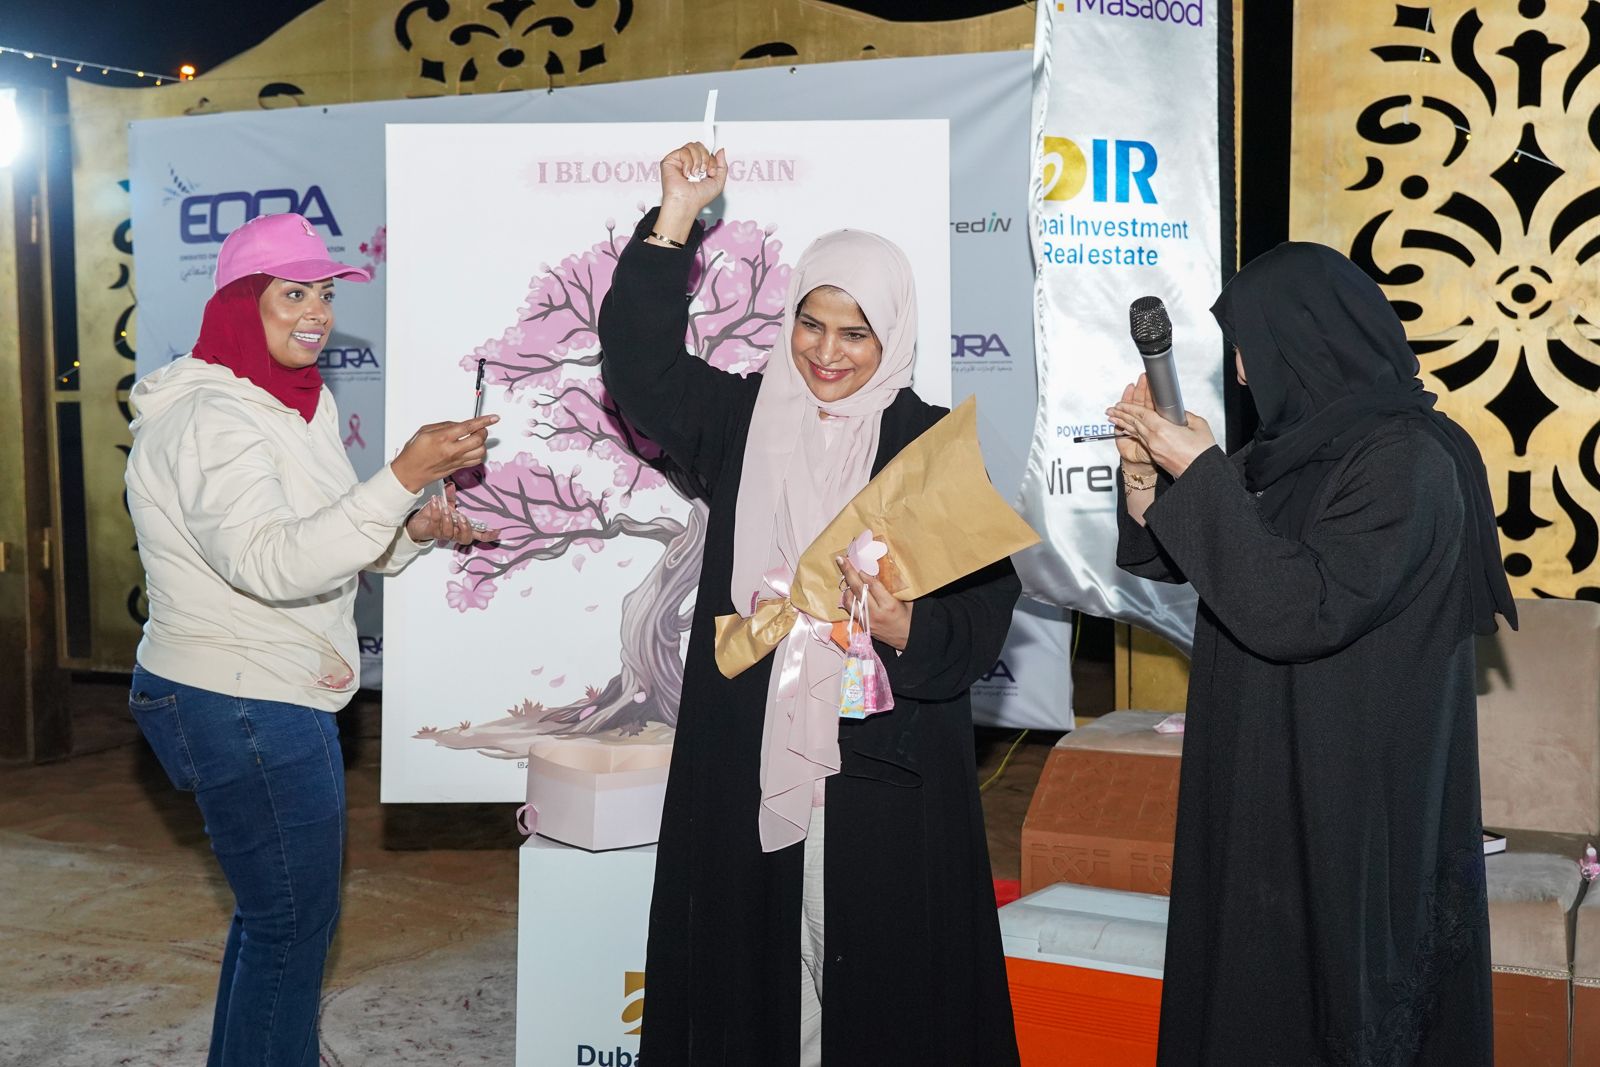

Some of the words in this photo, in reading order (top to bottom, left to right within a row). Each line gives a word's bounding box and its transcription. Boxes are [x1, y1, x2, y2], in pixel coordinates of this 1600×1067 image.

[538, 161, 548, 184] I
[555, 161, 660, 184] BLOOM
[728, 160, 795, 182] GAIN
[1070, 215, 1188, 239] Investment
[1088, 246, 1158, 266] estate
